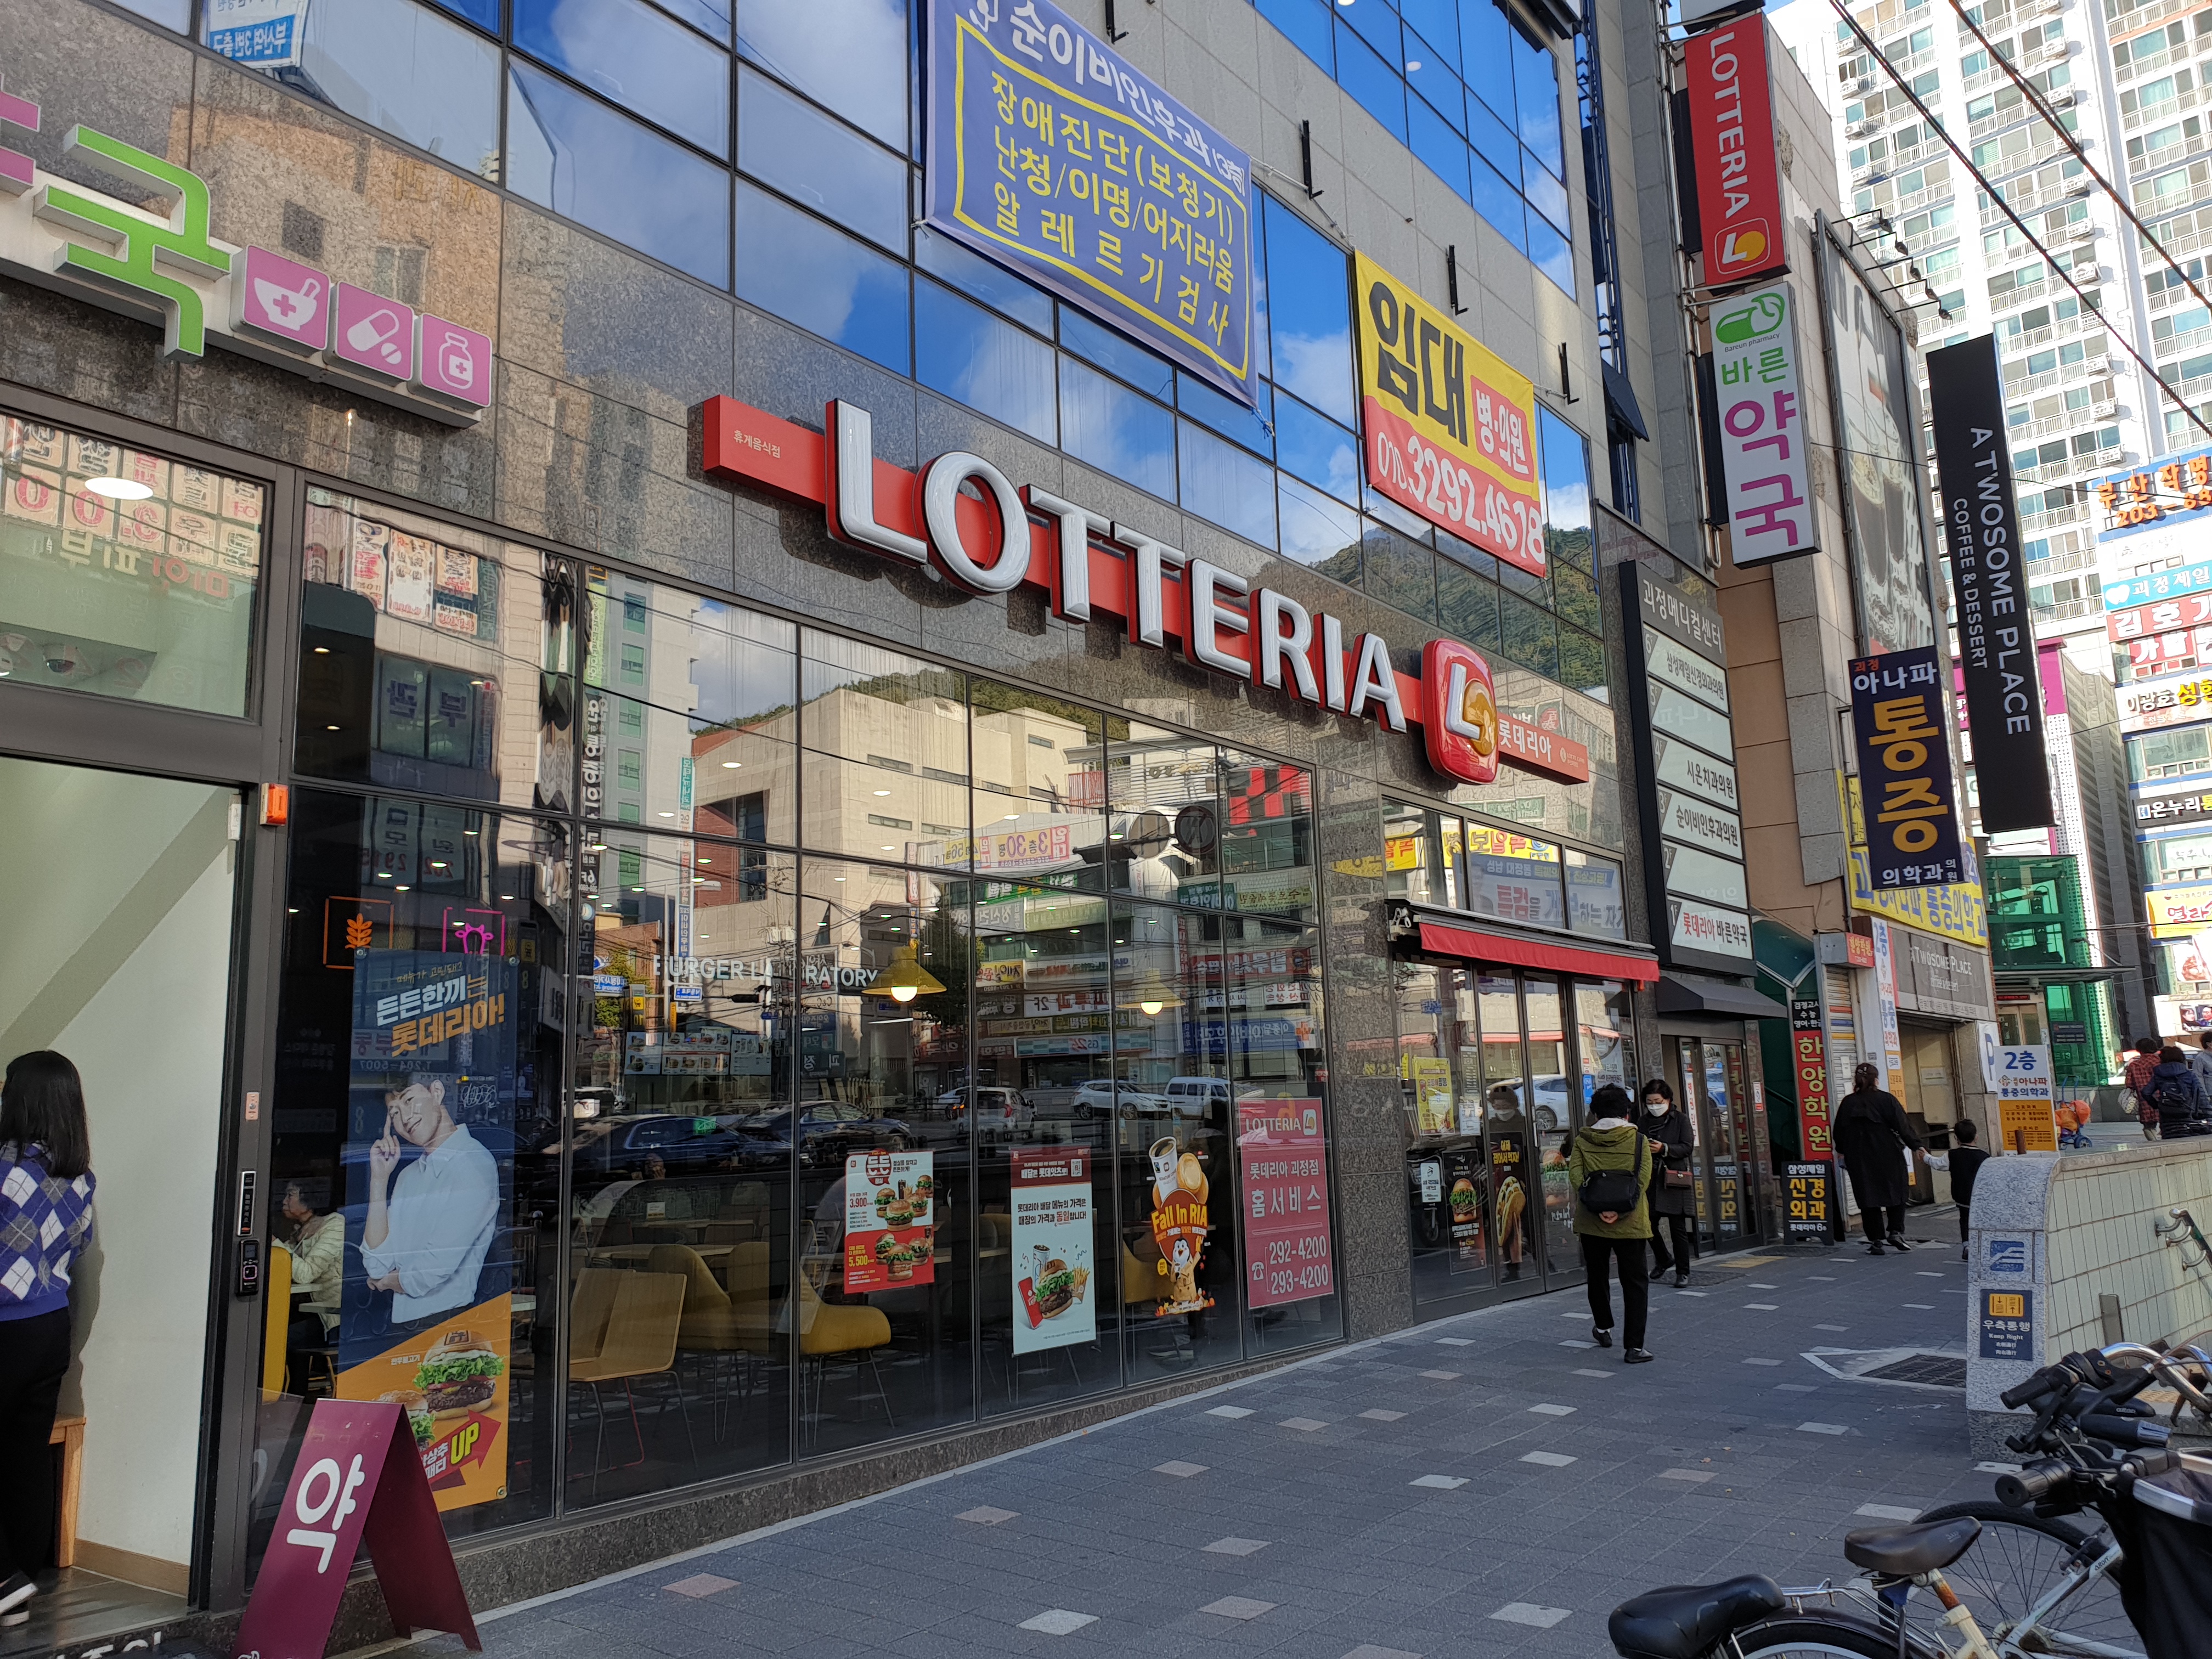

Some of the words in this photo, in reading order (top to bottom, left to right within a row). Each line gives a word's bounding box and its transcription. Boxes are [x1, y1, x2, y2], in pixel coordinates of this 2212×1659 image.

[1011, 0, 1209, 166] 순이비인후과
[1710, 32, 1750, 219] LOTTERIA
[992, 71, 1234, 245] 장애진단(보청기)
[995, 126, 1234, 294] 난청/이명/어지러움
[1724, 341, 1748, 353] Bareun
[1748, 332, 1780, 350] pharmacy
[1369, 282, 1468, 447] 임대
[1721, 347, 1789, 385] 바른
[733, 430, 781, 459] 휴게음식점
[1970, 427, 1994, 449] A
[1724, 390, 1804, 546] 약국
[1378, 432, 1547, 565] 010.3292.4618
[1953, 498, 1977, 569] COFFEE
[1974, 450, 2016, 615] TWOSOME
[836, 398, 1407, 734] LOTTERIA
[1962, 573, 1977, 586] &
[1643, 579, 1722, 655] 괴정메디컬센터
[1963, 587, 1990, 669] DESSERT
[1666, 651, 1724, 701] 삼성제일신경외과의원
[1854, 659, 1880, 672] 괴정
[1854, 662, 1938, 695] 아나파
[1995, 627, 2030, 734] PLACE
[1499, 717, 1551, 763] 롯데리아
[1686, 759, 1734, 800] 시온치과의원
[1869, 695, 1949, 853] 통증
[1675, 806, 1739, 847] 순이비인후과의원
[1882, 864, 1944, 885] 의학과
[1945, 859, 1959, 883] 의원
[1683, 912, 1715, 943] 롯데리아
[1716, 919, 1748, 948] 바른약국
[1950, 955, 1972, 975] PLACE
[376, 974, 489, 1026] 든든한끼는
[392, 994, 505, 1057] 롯데리아!
[2004, 1051, 2037, 1070] 2층
[1798, 1036, 1832, 1151] 한양학원
[2019, 1077, 2048, 1086] 아나파
[1246, 1118, 1301, 1132] LOTTERIA
[1250, 1161, 1288, 1180] 롯데리아
[1290, 1158, 1319, 1177] 괴정점
[1789, 1177, 1825, 1199] 신경
[1152, 1205, 1175, 1234] Fall
[1177, 1204, 1188, 1225] In
[1189, 1204, 1207, 1227] RIA
[1251, 1184, 1321, 1217] 홈서비스
[1790, 1199, 1826, 1221] 외과
[849, 1255, 868, 1267] 5,500
[1269, 1235, 1327, 1265] 292-4200
[1271, 1263, 1329, 1295] 293-4200
[1982, 1319, 2030, 1333] 우측통행
[450, 1422, 480, 1465] UP
[287, 1454, 365, 1575] 약
